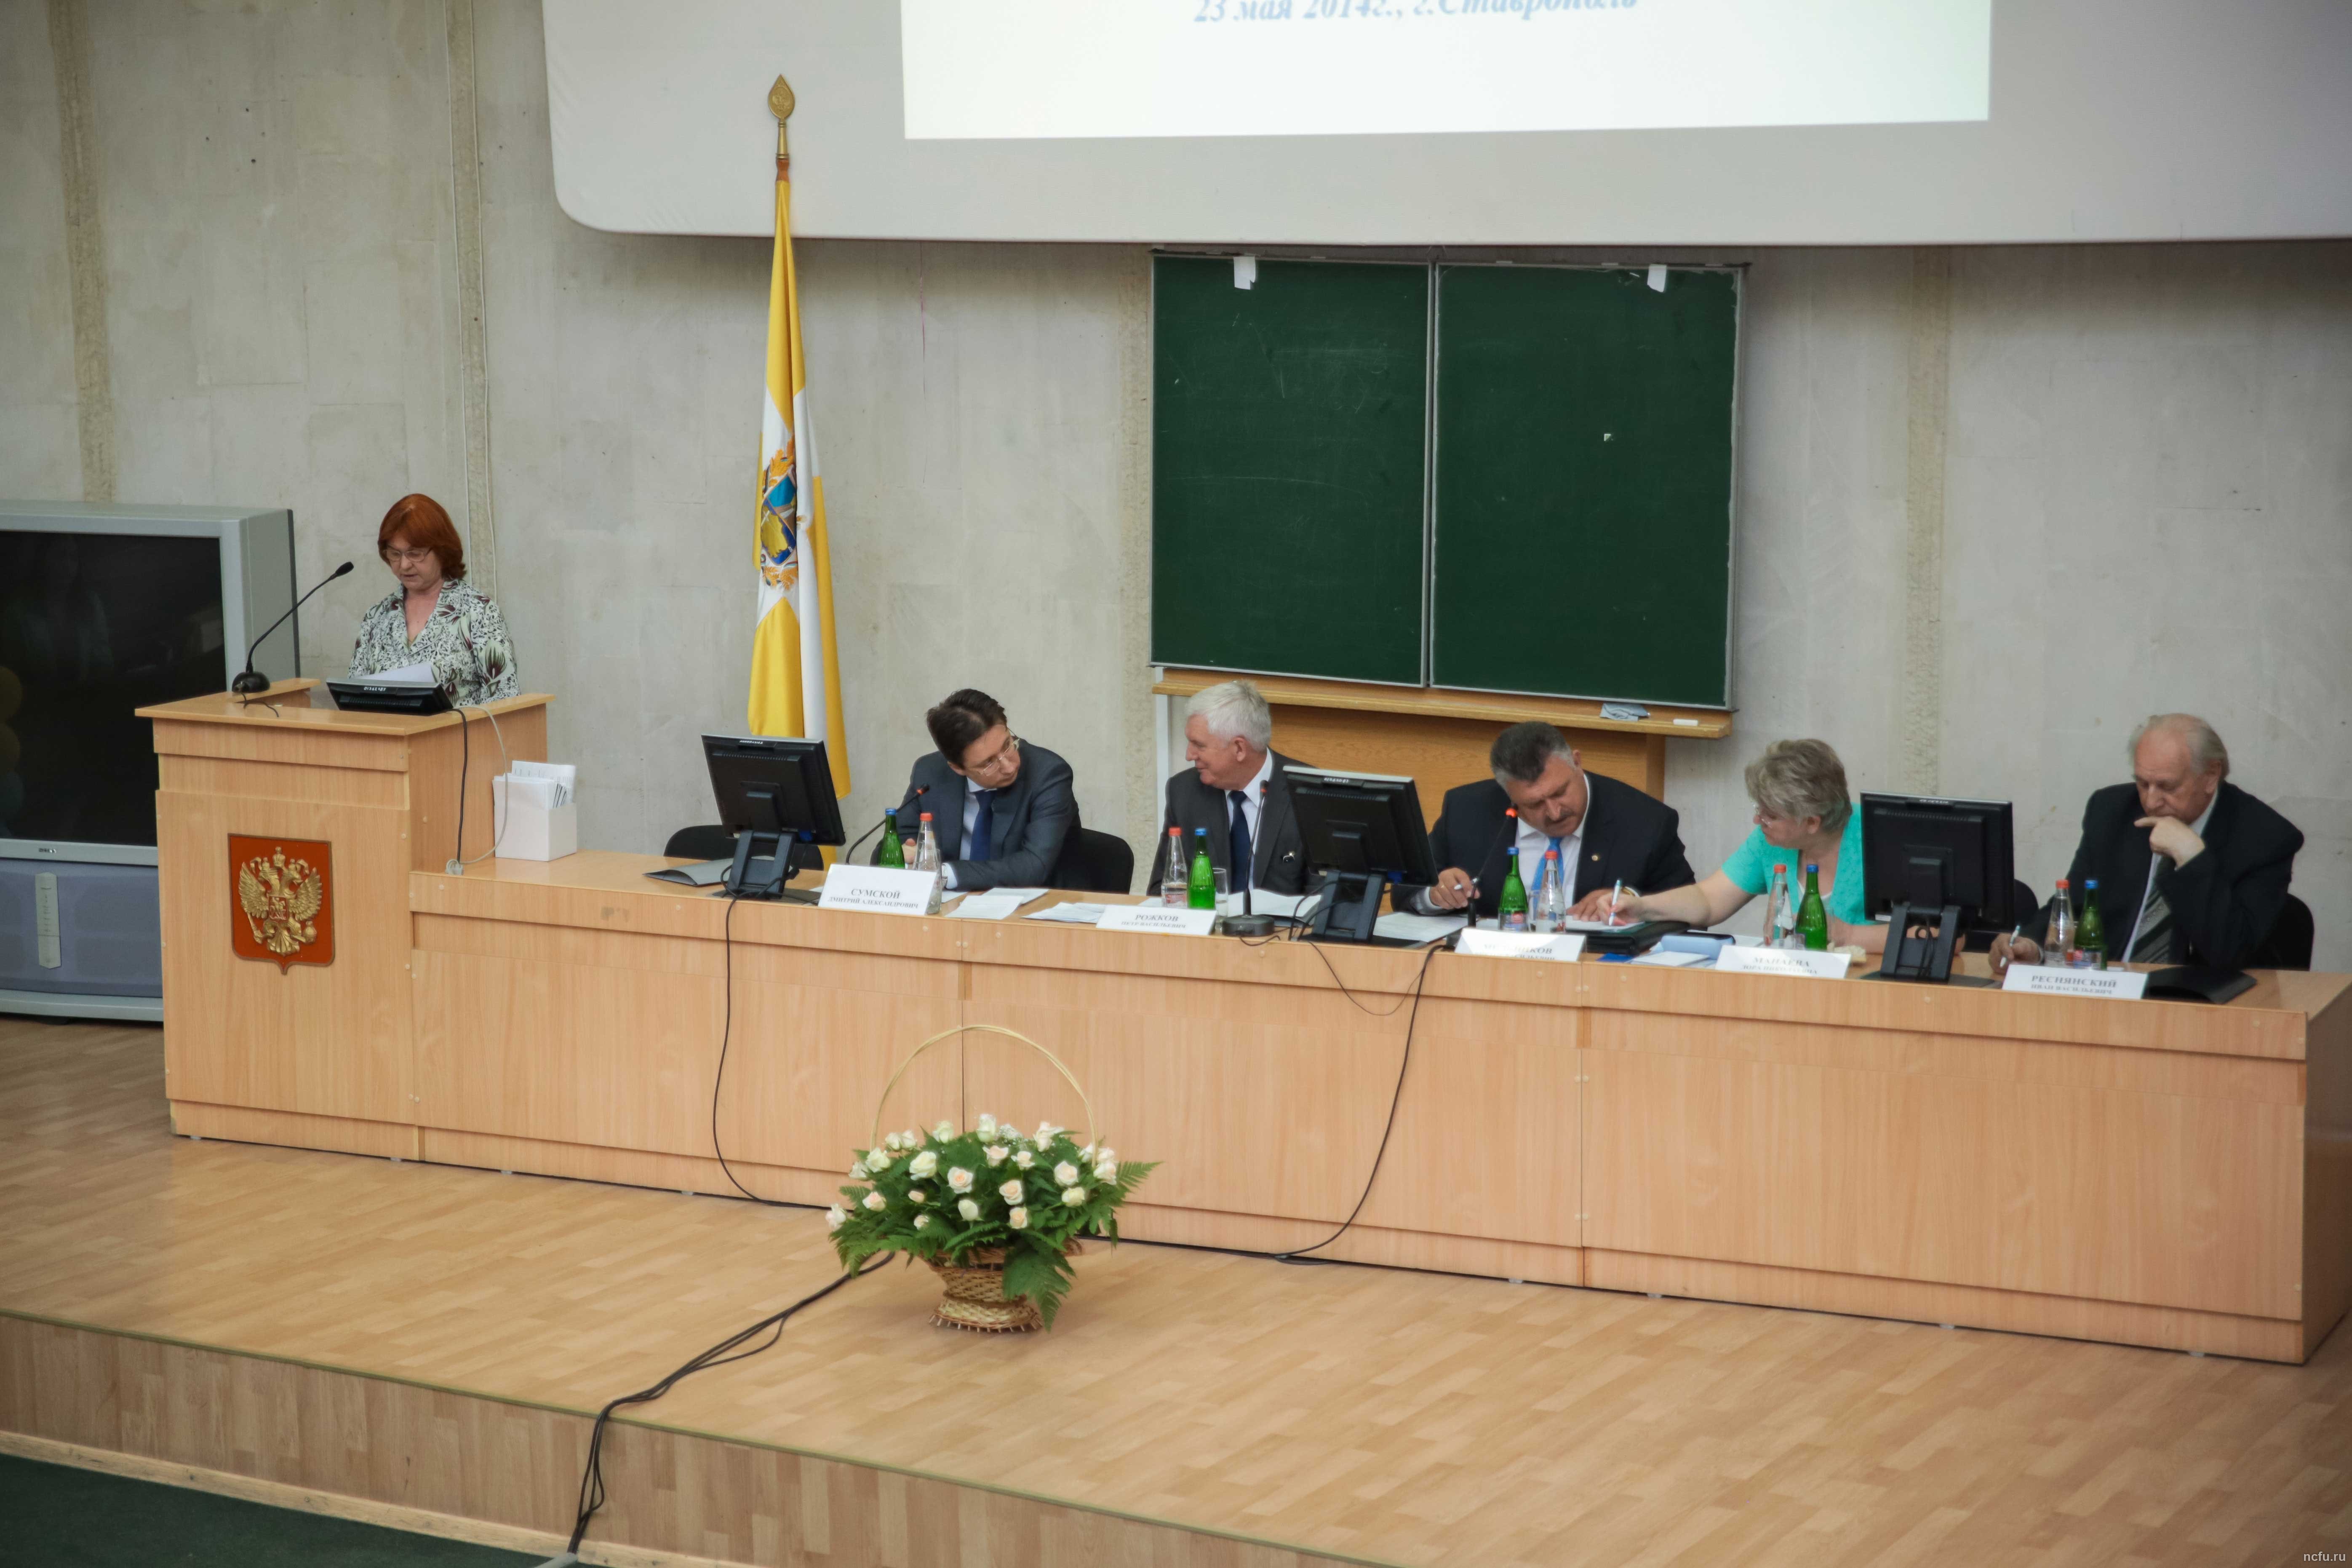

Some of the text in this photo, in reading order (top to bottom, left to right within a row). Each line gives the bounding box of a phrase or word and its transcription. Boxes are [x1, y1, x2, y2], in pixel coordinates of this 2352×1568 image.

[1193, 0, 1225, 22] 23
[1233, 0, 1292, 21] мая
[851, 888, 900, 899] СУМСКОЙ
[862, 900, 918, 908] АЛЕКСАНДРОВИЧ
[2032, 975, 2117, 988] РЕСНЯНСКИЙ
